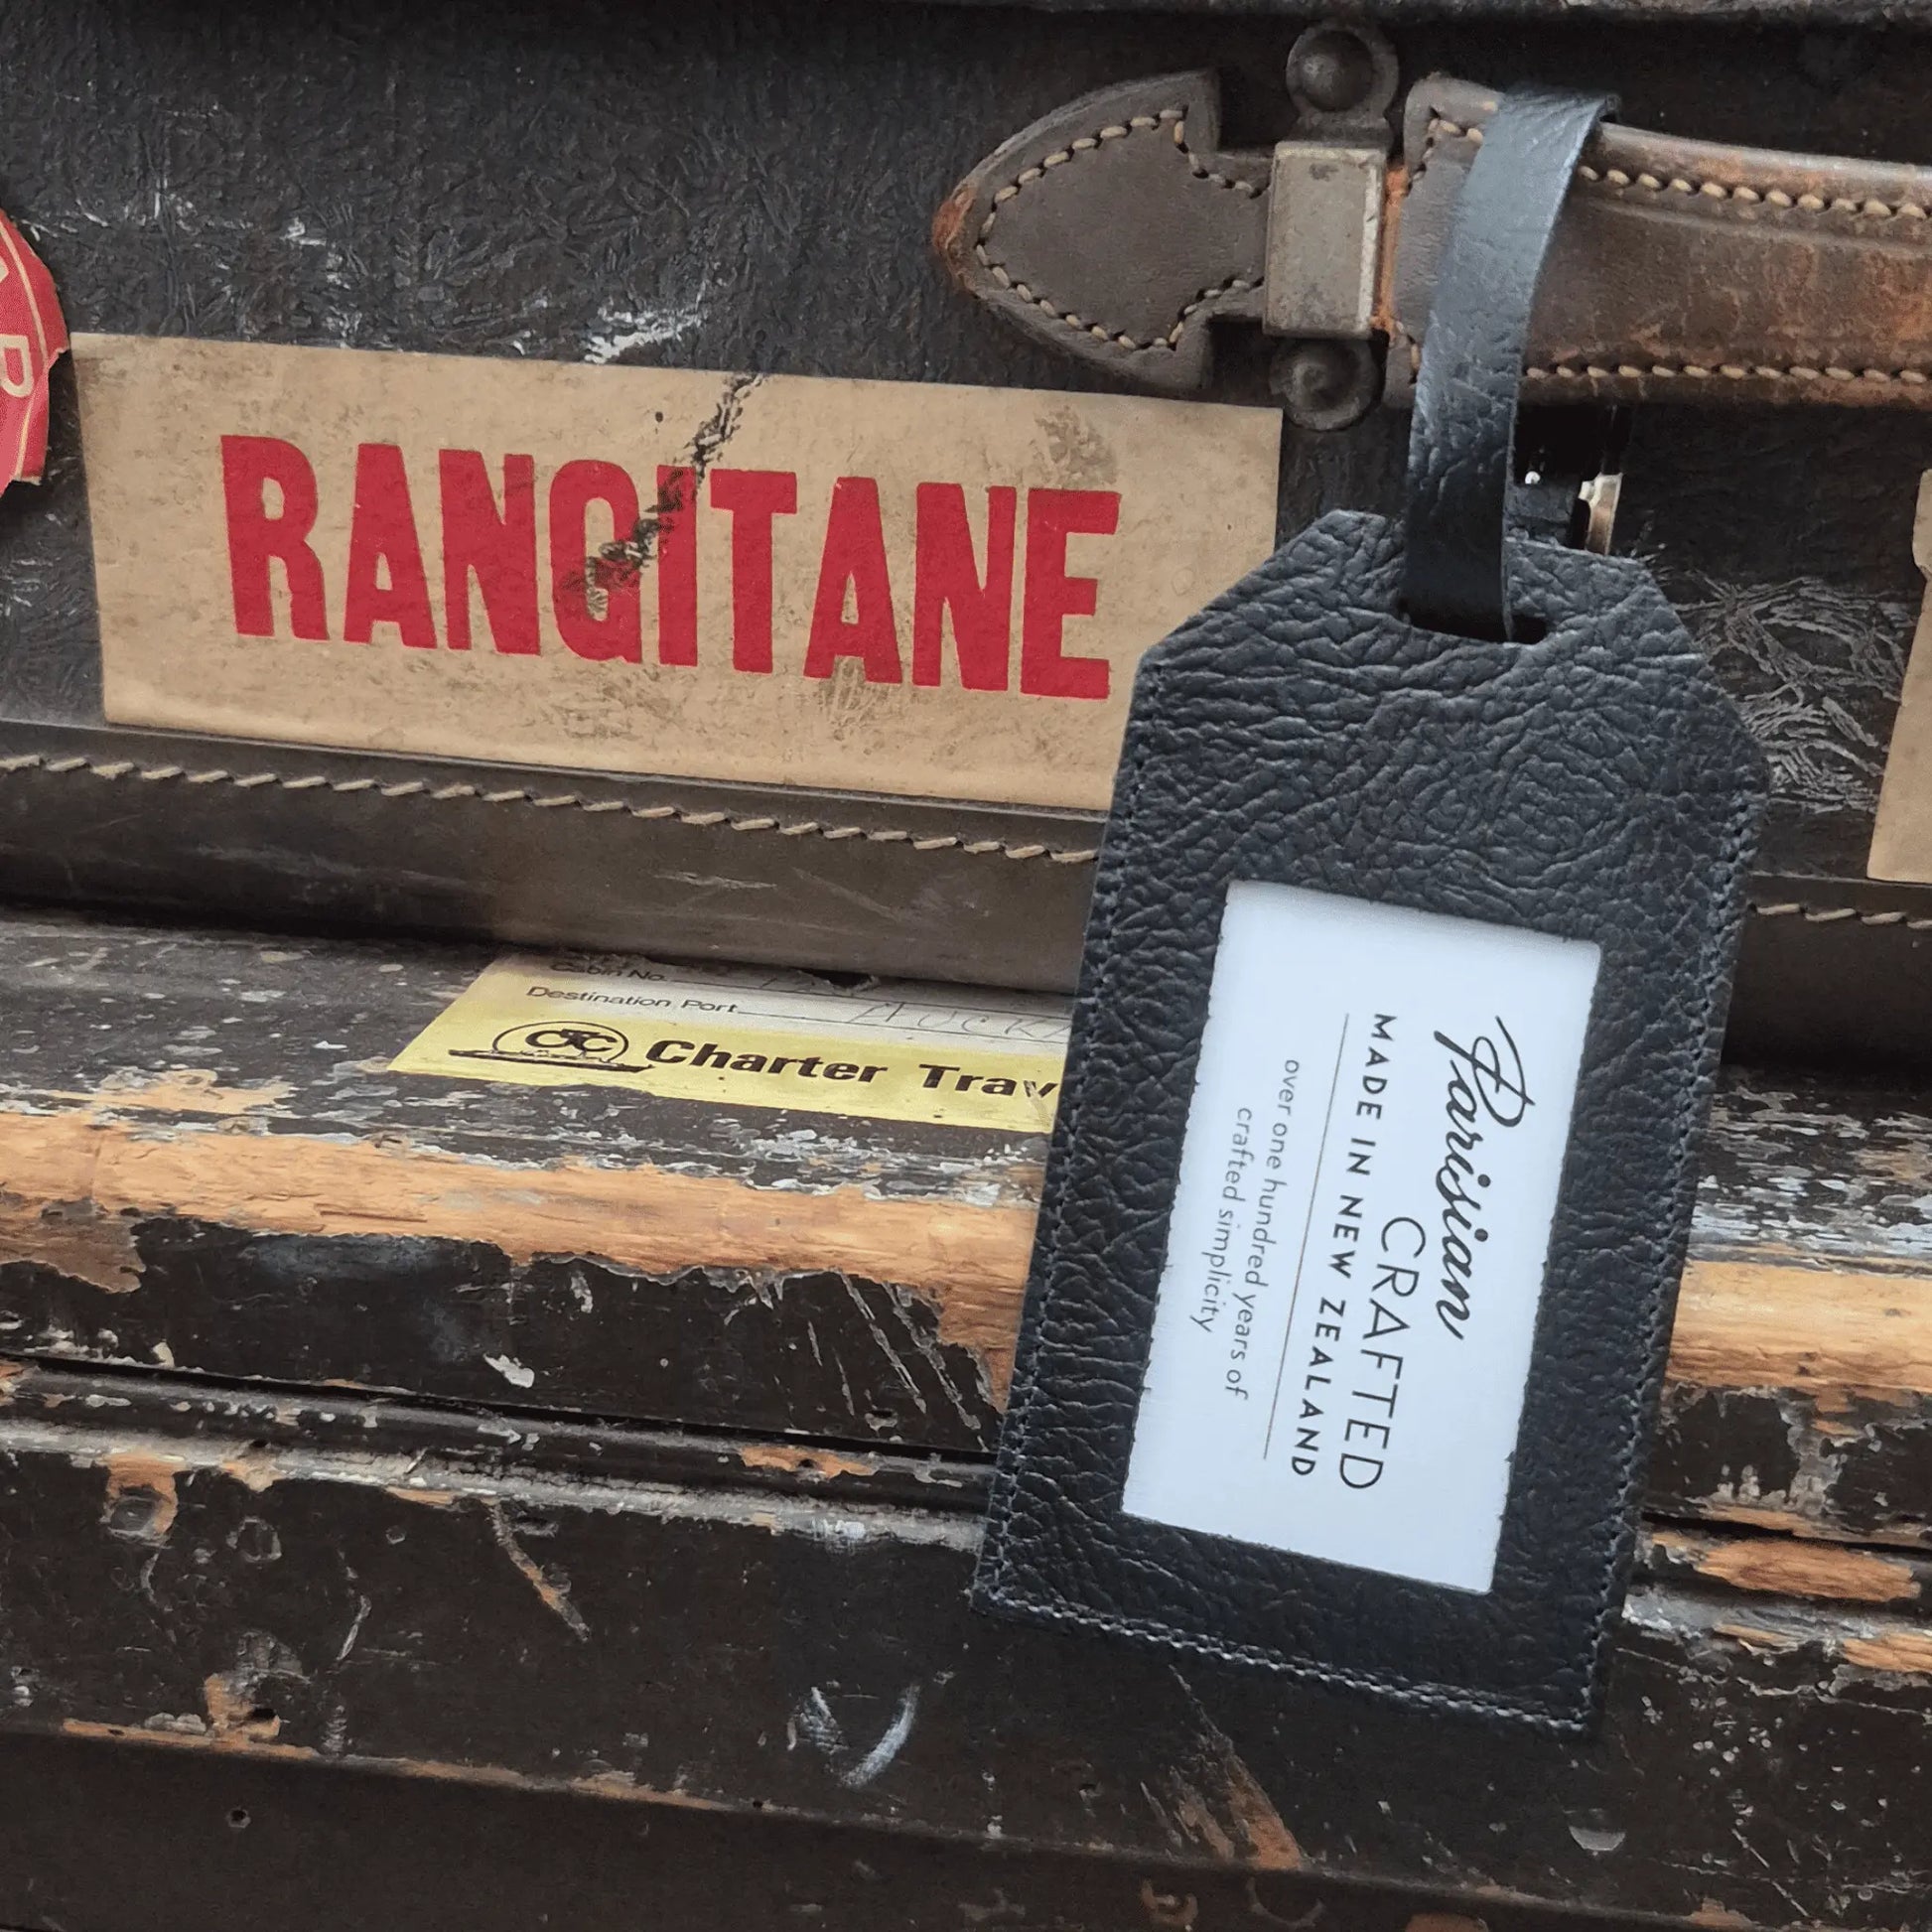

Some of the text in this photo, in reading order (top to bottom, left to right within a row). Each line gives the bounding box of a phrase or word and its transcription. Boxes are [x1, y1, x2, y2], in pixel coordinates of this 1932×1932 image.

[220, 435, 1120, 700] RANGITANE
[526, 986, 739, 1015] Destination Port
[644, 1039, 889, 1084] Charter
[1189, 1107, 1255, 1333] crafted simplicity
[1224, 1058, 1302, 1401] over one hundred years of
[1291, 1013, 1398, 1476] MADE IN NEW ZEALAND
[1433, 1015, 1537, 1341] Parisian
[1338, 1216, 1427, 1490] CRAFTED
